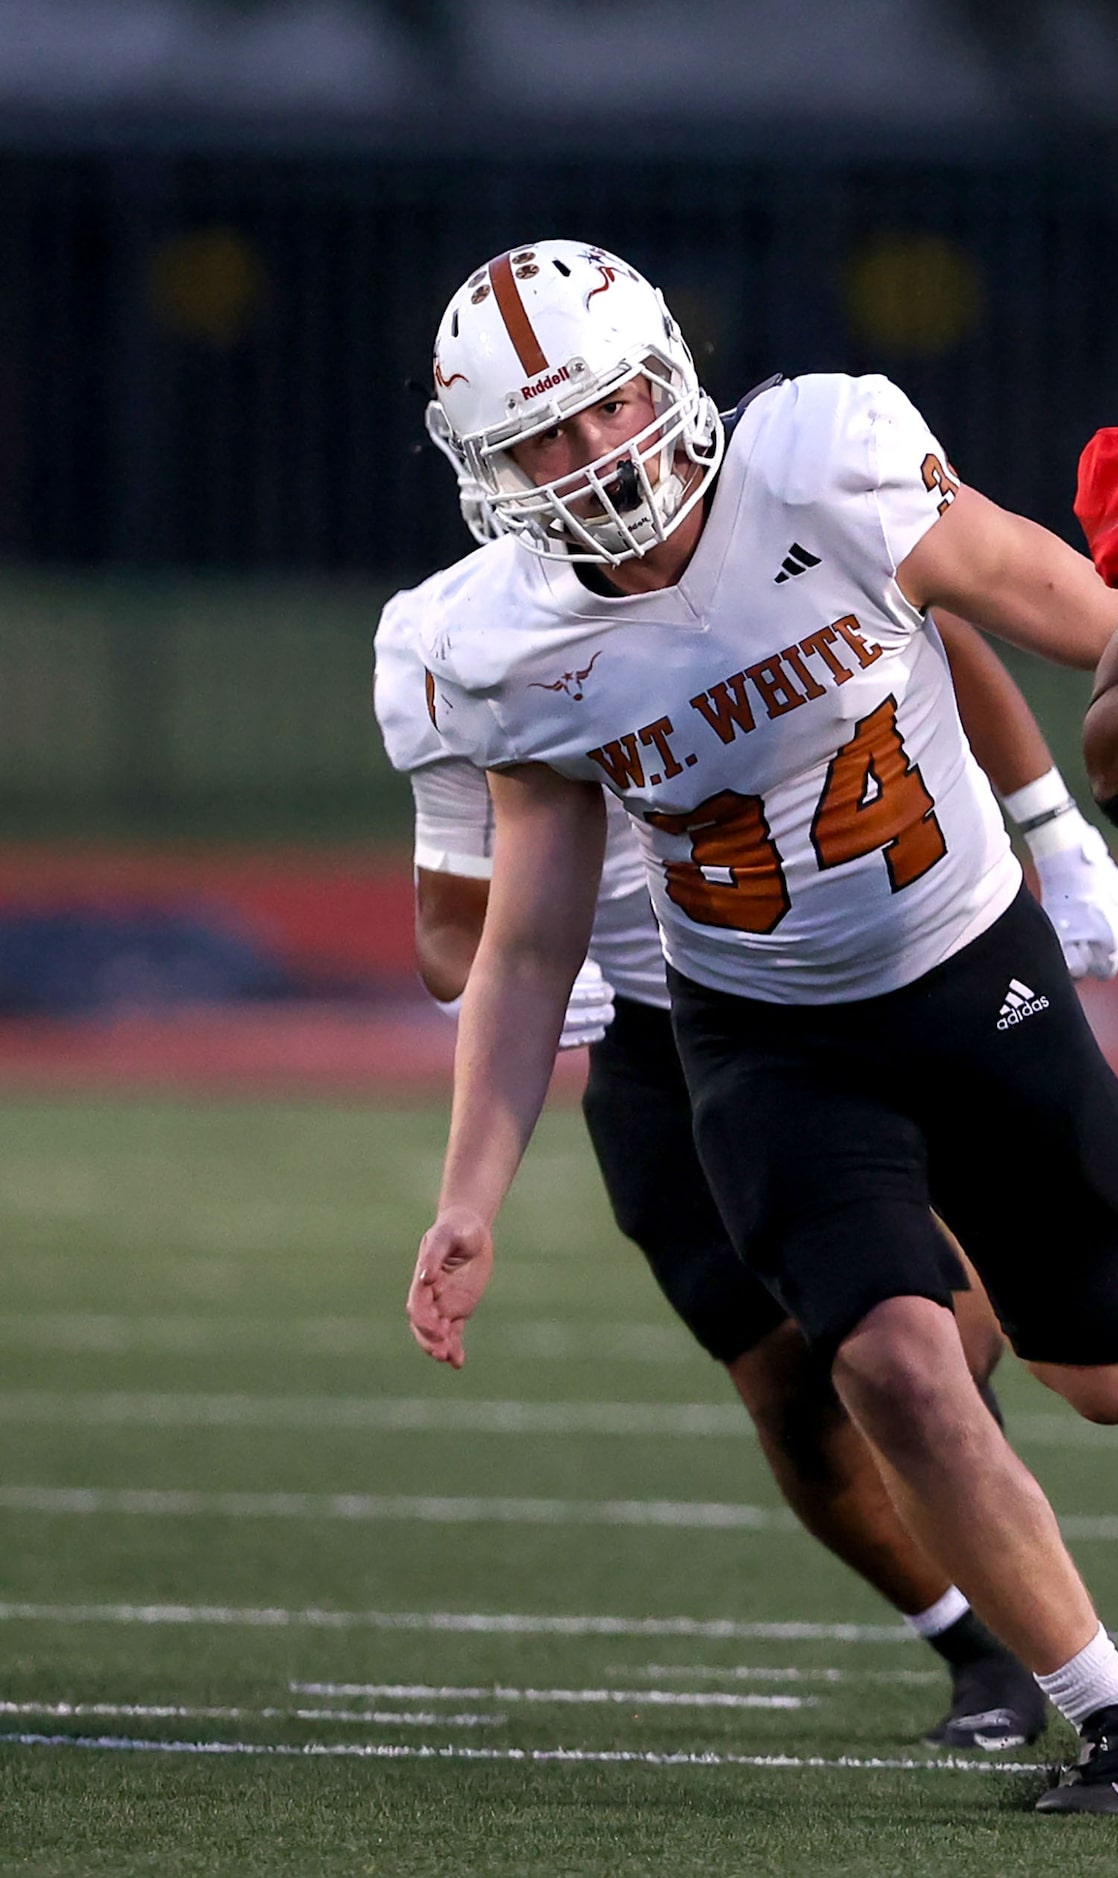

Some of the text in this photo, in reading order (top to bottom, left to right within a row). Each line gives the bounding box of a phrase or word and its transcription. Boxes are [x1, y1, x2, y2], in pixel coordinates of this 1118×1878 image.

[520, 365, 571, 401] Riddell
[586, 612, 884, 790] W.T. WHITE
[643, 692, 949, 935] 34
[996, 995, 1050, 1031] adidas
